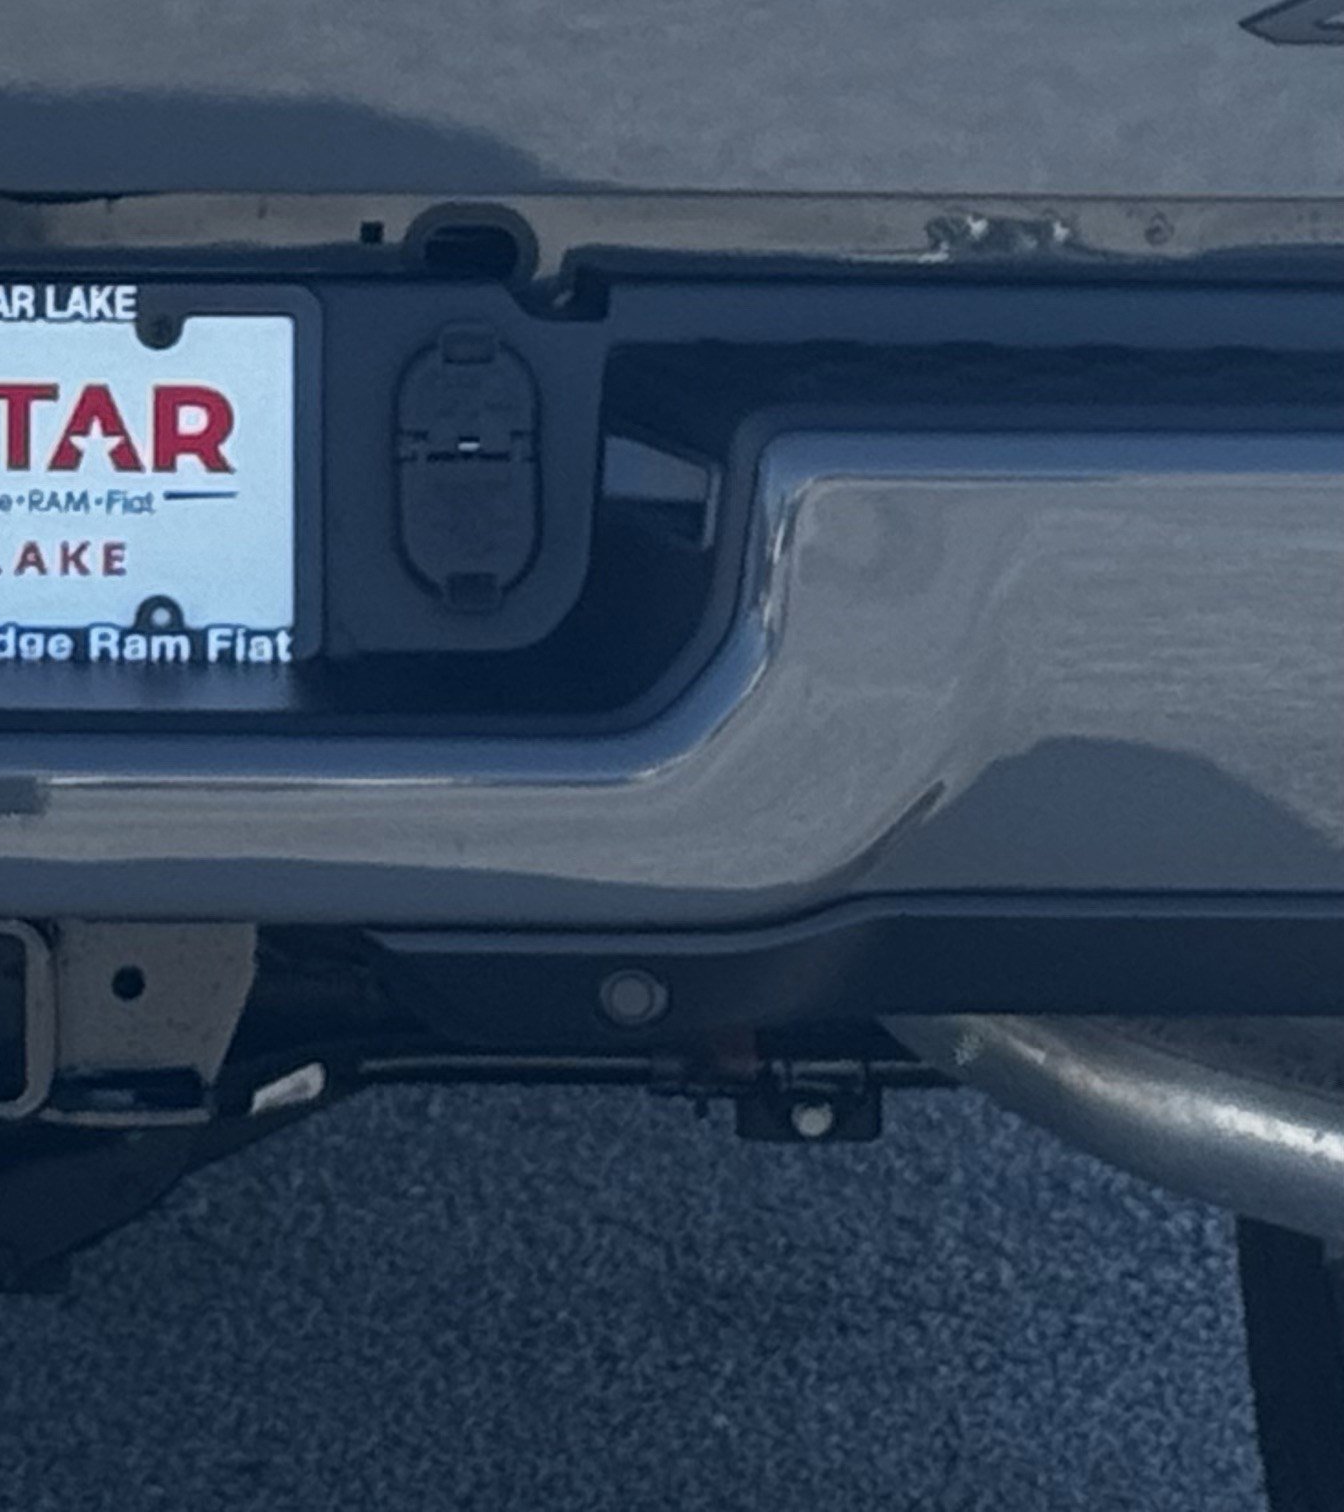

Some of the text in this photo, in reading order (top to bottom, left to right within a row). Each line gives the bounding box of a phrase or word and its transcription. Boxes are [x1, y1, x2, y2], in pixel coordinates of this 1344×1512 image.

[44, 284, 138, 320] LAKE
[27, 489, 90, 513] RAM
[105, 489, 156, 515] Fiat
[88, 626, 191, 662] Ram
[207, 627, 294, 663] Fiat
